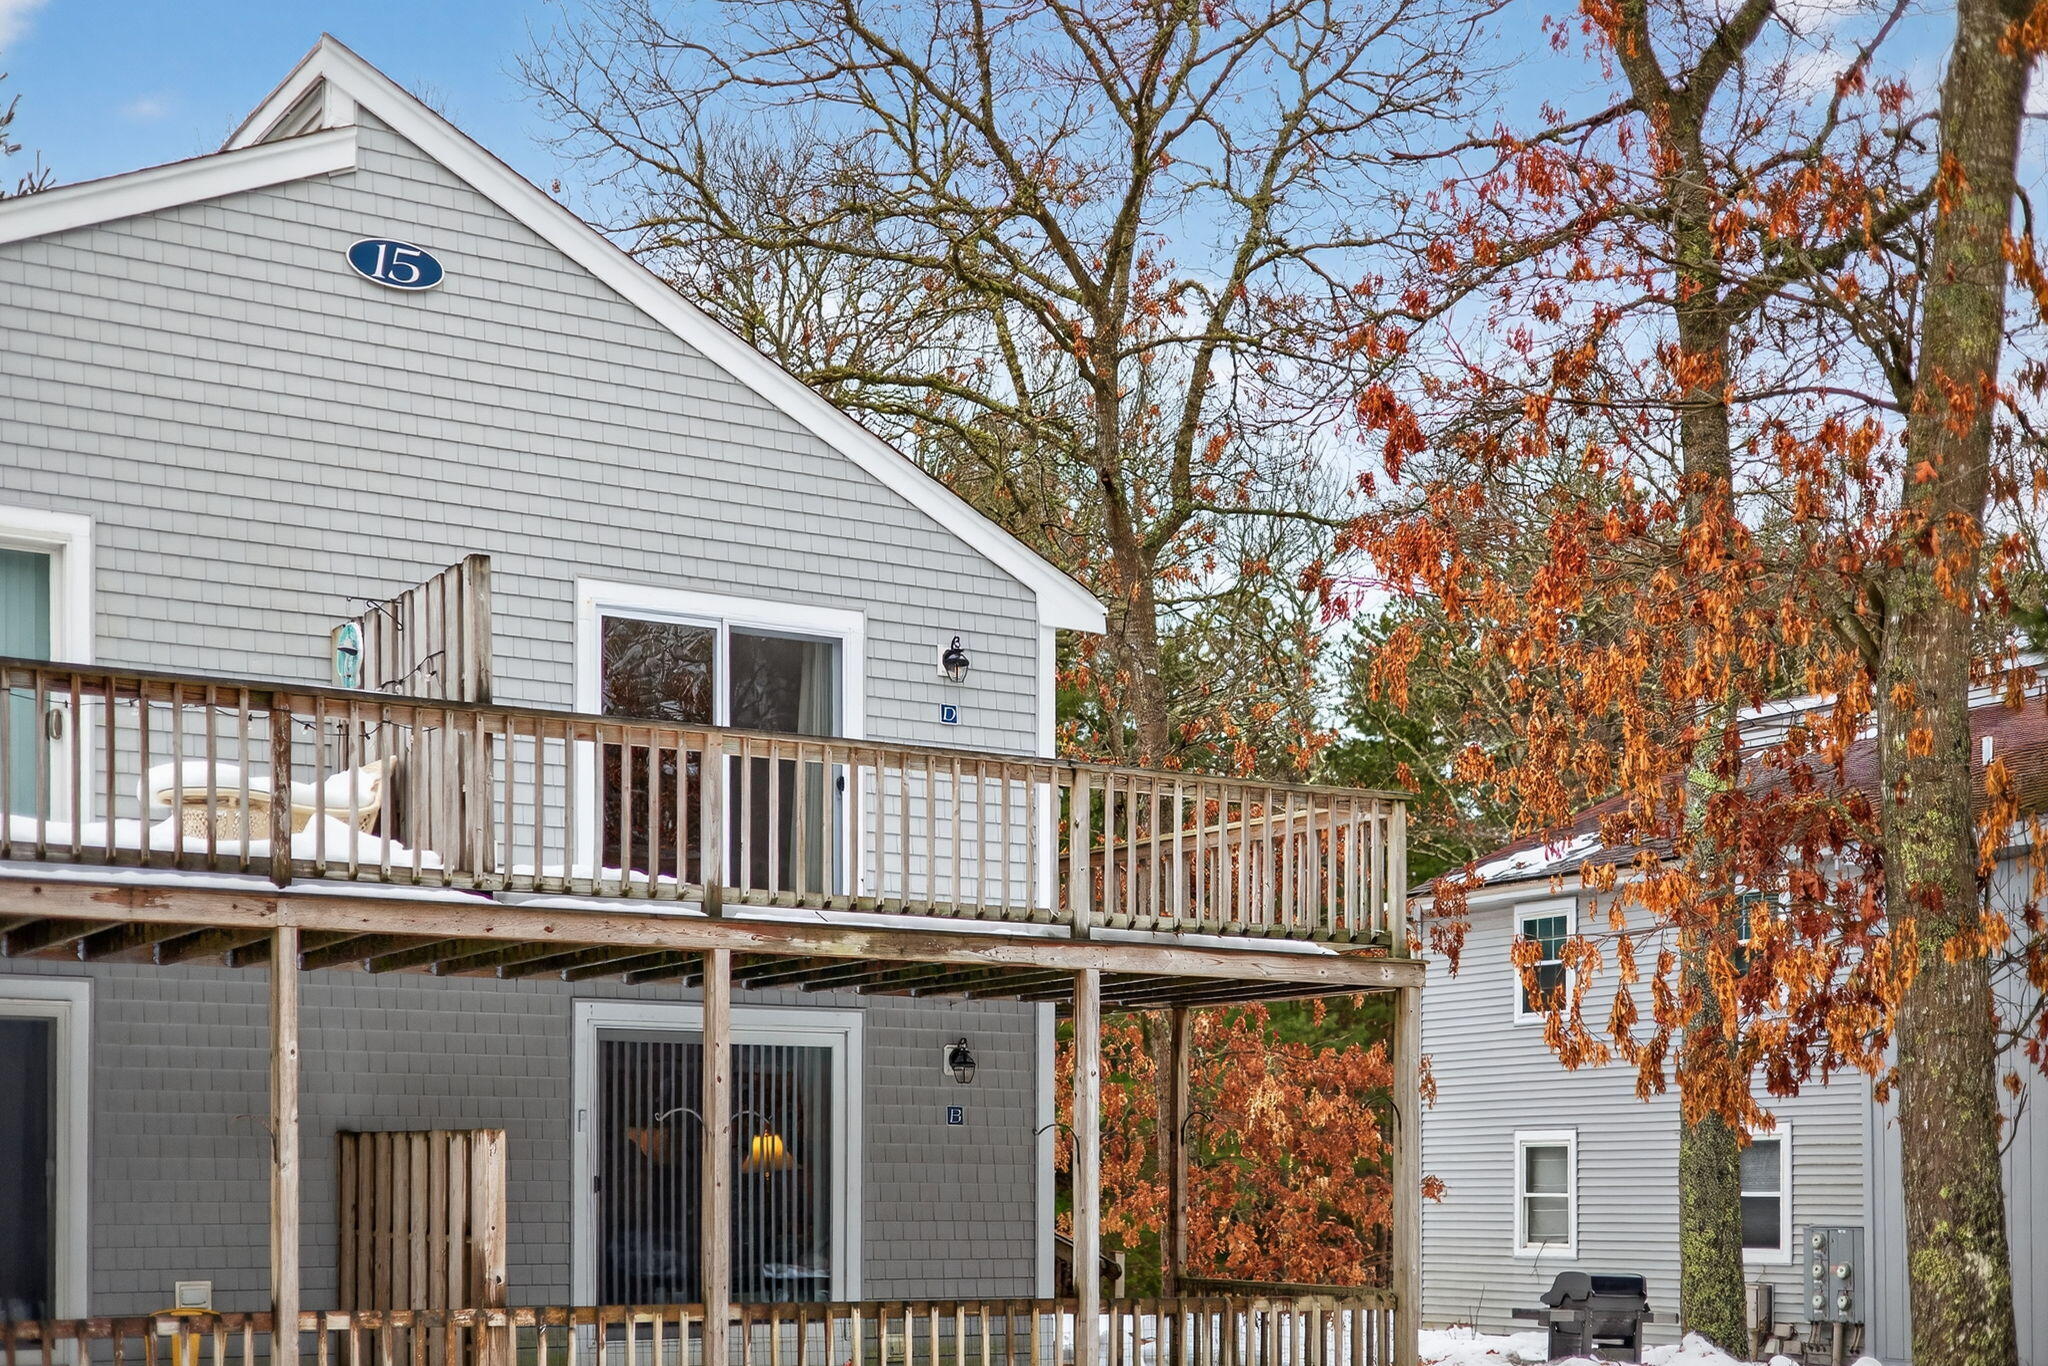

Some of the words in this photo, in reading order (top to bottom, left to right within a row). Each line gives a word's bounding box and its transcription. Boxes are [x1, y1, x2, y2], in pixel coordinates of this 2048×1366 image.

[371, 244, 420, 283] 15
[943, 706, 956, 721] D
[950, 1109, 961, 1123] B
